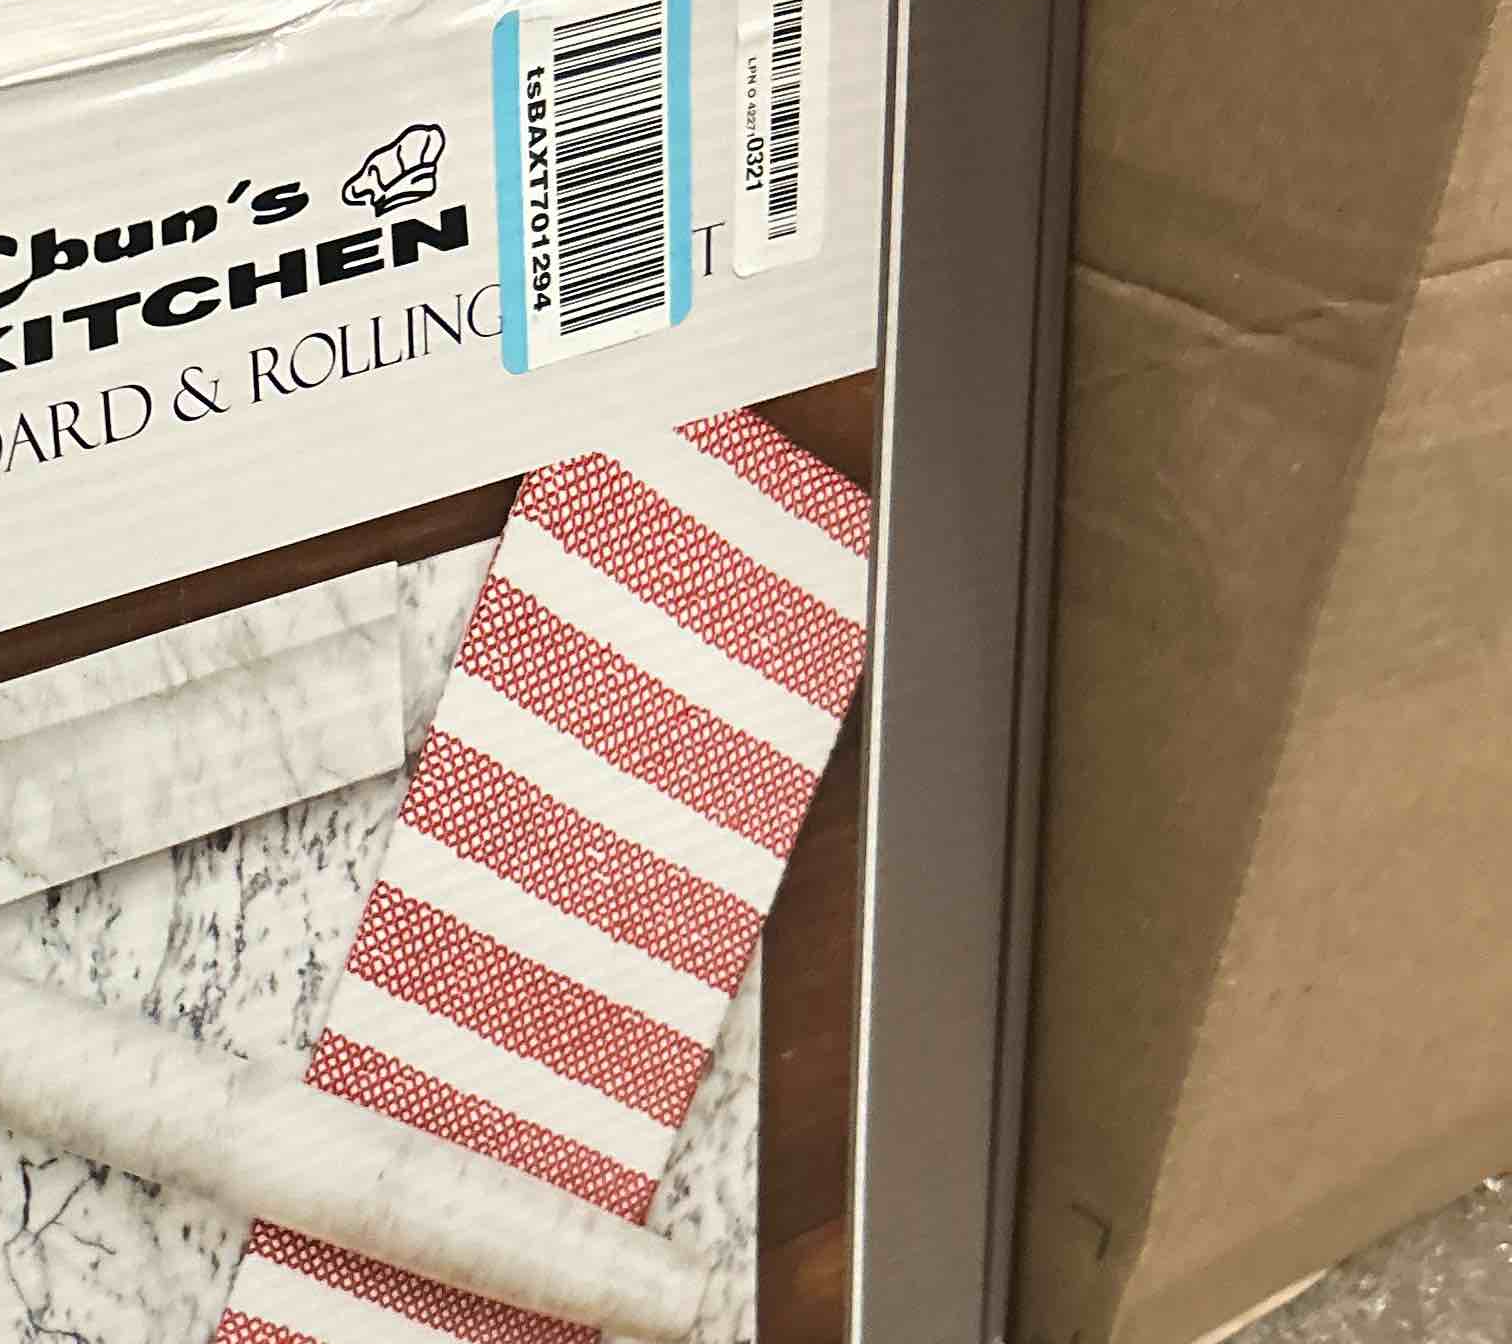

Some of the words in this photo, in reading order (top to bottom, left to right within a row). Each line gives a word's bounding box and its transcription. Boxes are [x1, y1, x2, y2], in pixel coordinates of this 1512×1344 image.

[525, 65, 551, 311] tsBAXT701294
[172, 365, 230, 422] &
[248, 283, 505, 406] ROLLING
